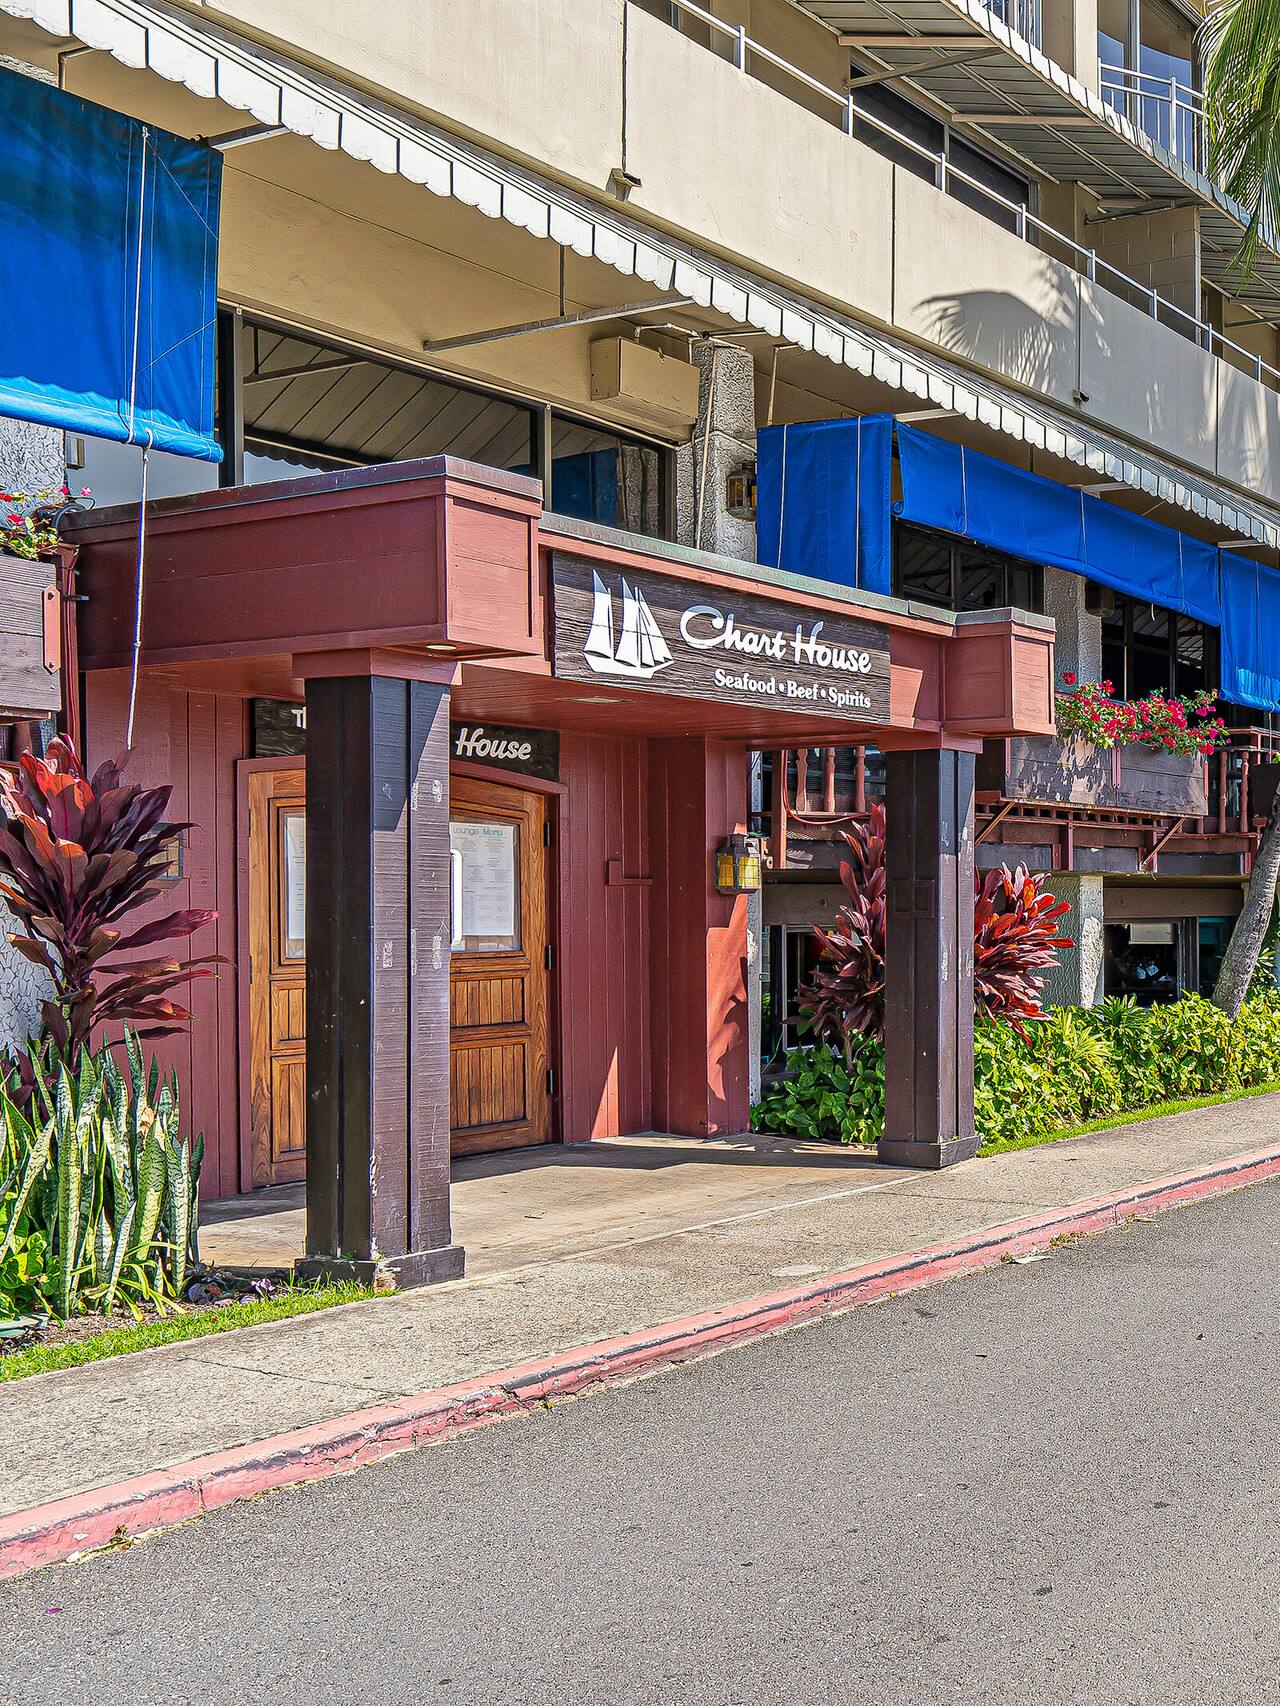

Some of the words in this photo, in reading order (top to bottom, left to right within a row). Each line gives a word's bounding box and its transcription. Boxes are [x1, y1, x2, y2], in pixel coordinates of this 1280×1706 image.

[679, 605, 787, 657] Chart
[788, 621, 872, 674] House
[714, 669, 776, 696] Seafood
[786, 680, 819, 701] Beef
[828, 687, 872, 710] Spirits
[455, 727, 532, 760] House
[453, 827, 480, 836] Lounge
[482, 827, 504, 836] Menu
